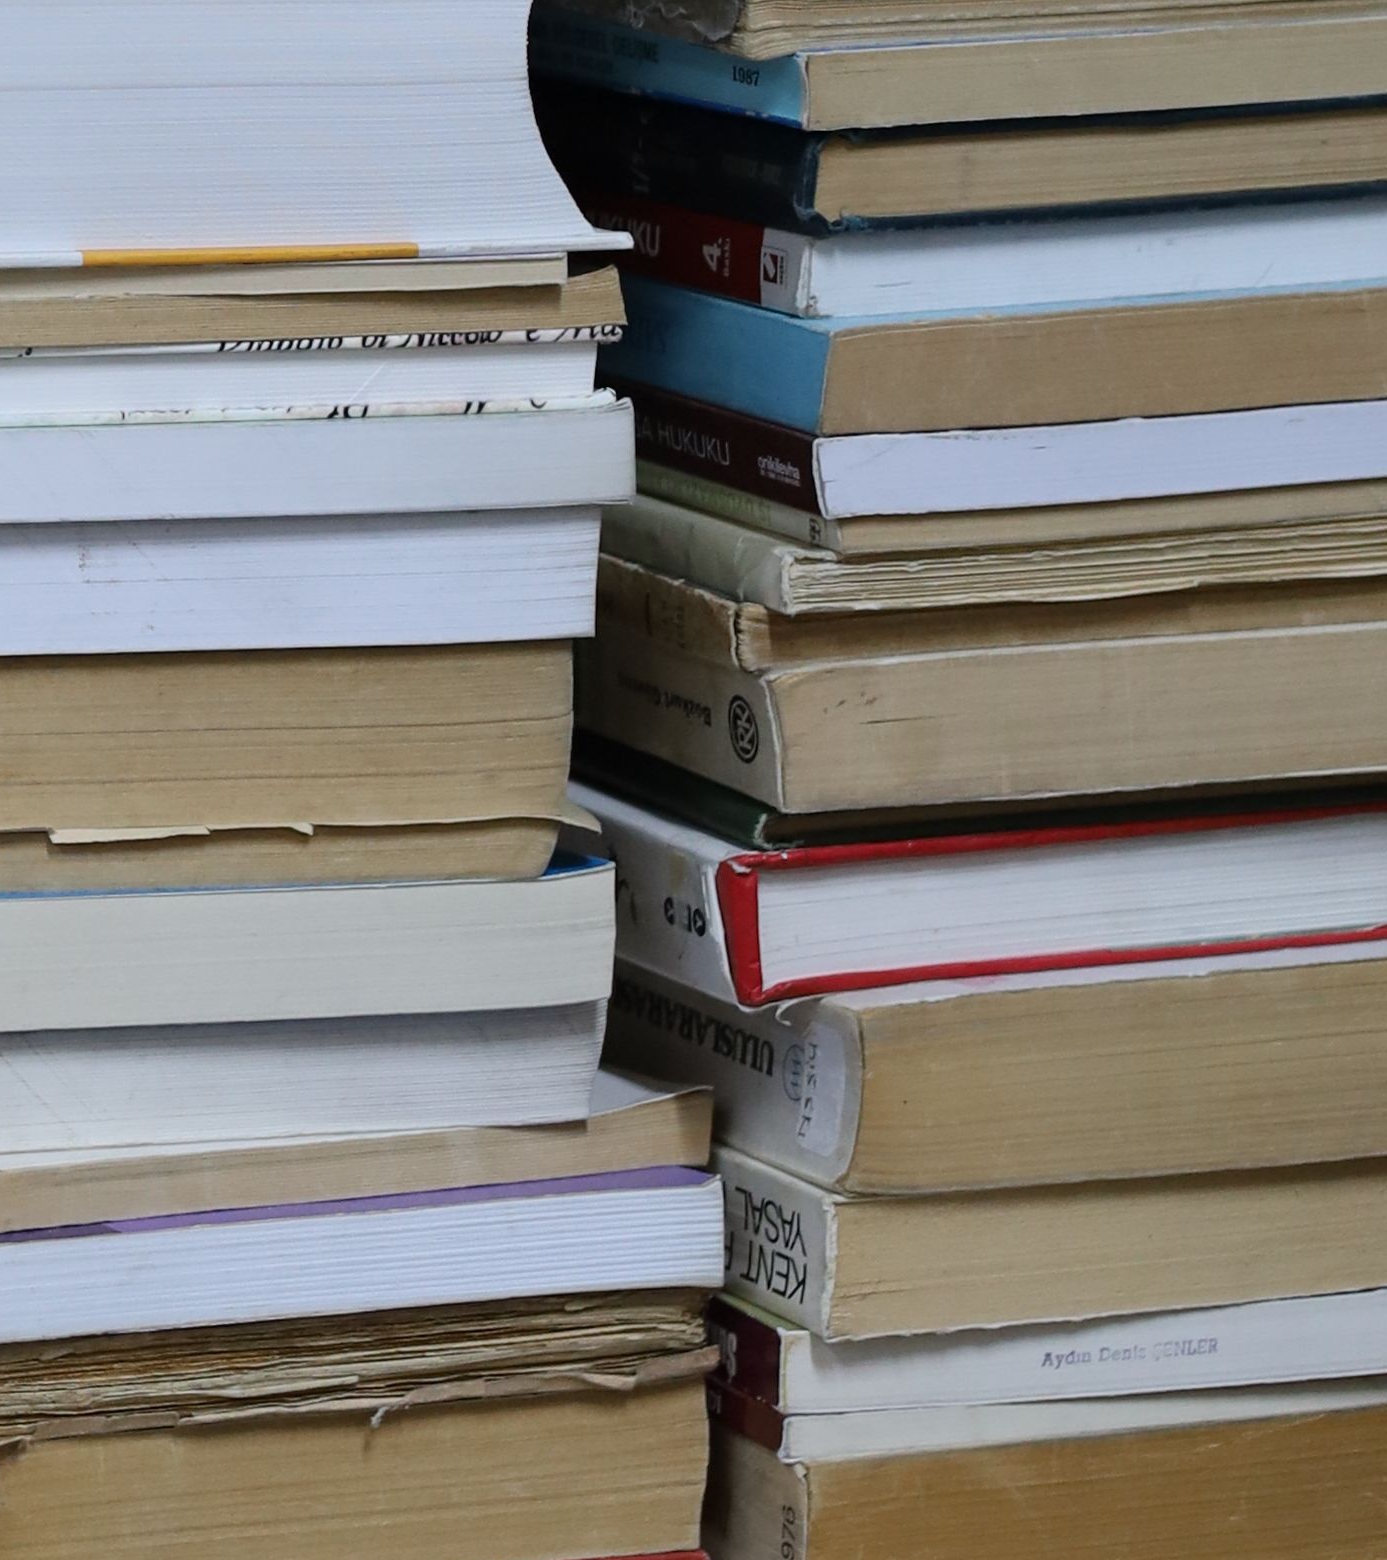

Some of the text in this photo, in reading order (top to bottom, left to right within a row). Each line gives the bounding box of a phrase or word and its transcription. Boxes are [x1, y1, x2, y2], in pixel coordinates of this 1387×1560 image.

[658, 425, 730, 466] HUKUKU
[735, 1187, 807, 1258] YASAL
[740, 1240, 807, 1305] KENT
